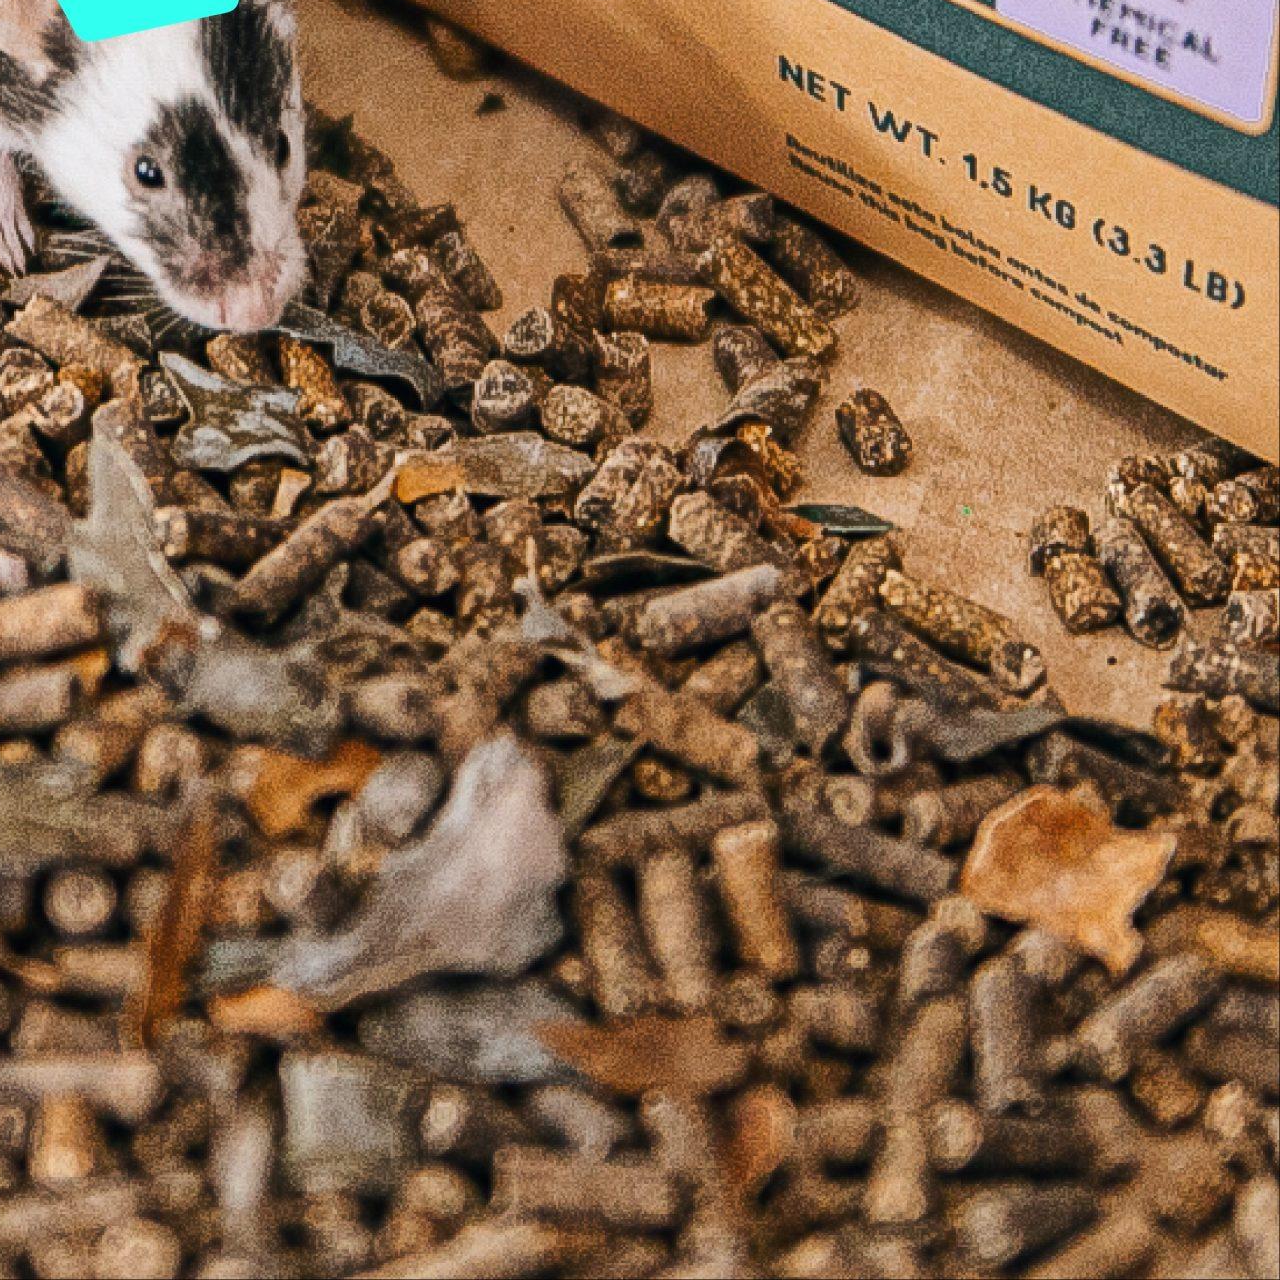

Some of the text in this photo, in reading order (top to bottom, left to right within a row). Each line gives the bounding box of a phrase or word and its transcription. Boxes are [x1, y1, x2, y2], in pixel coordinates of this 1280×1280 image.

[1091, 18, 1172, 71] FREE
[778, 55, 1245, 310] NET WT. 1.5 KG (3.3 LB)
[904, 213, 947, 251] bag
[951, 238, 1023, 290] before
[940, 216, 1000, 258] bolsa
[1007, 257, 1068, 296] antes
[1075, 291, 1100, 313] de
[1107, 311, 1228, 382] compostar
